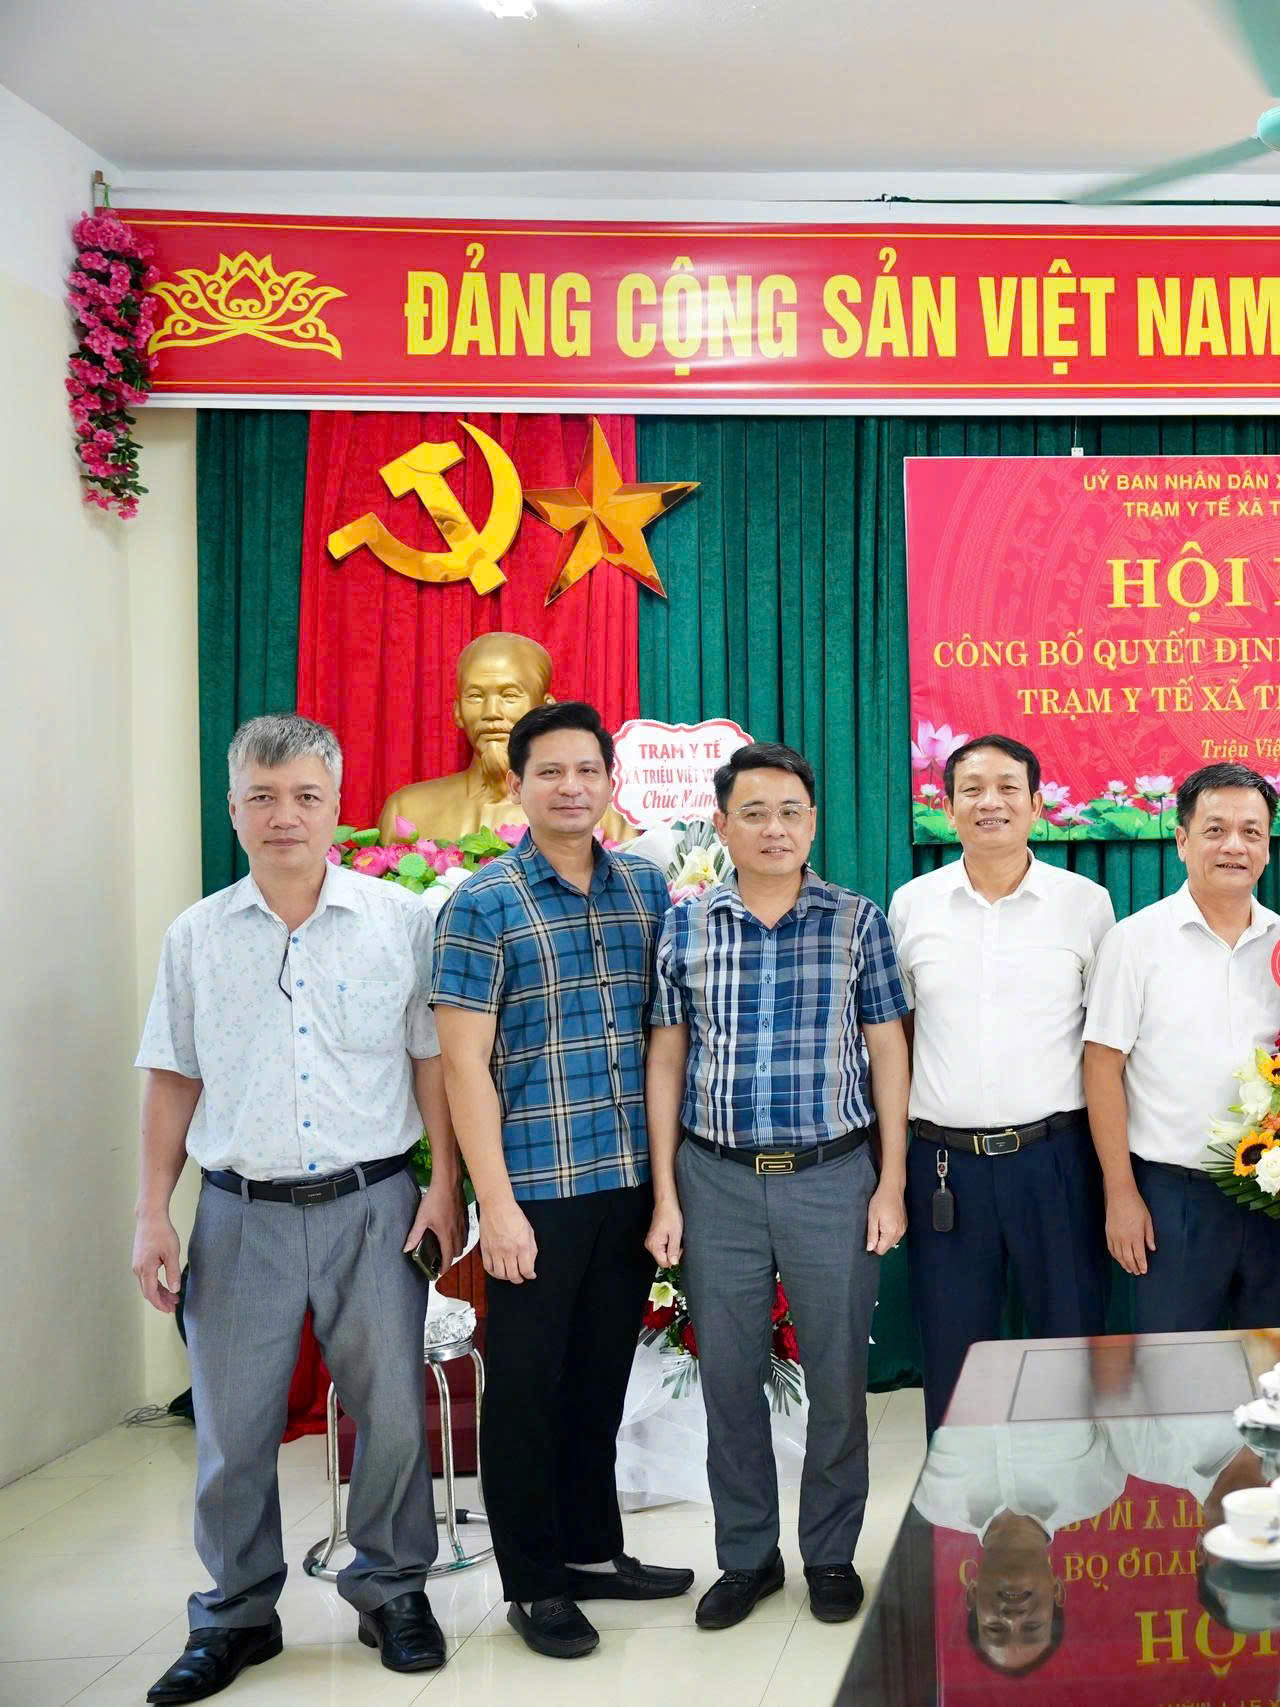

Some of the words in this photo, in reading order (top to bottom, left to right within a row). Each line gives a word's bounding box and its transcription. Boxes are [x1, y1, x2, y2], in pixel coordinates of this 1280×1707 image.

[404, 242, 591, 357] ĐẢNG
[617, 256, 798, 376] CỘNG
[821, 246, 957, 359] SẢN
[978, 258, 1115, 375] VIỆT
[1083, 468, 1109, 491] UỶ
[1116, 474, 1158, 490] BAN
[1165, 470, 1220, 490] NHÂN
[1228, 470, 1269, 490] DÂN
[1124, 501, 1180, 521] TRẠM
[1186, 501, 1199, 517] Y
[1205, 495, 1231, 517] TẾ
[1237, 497, 1264, 516] XÃ
[1106, 541, 1252, 624] HỘI
[933, 633, 1029, 668] CÔNG
[1039, 628, 1085, 667] BỐ
[1093, 628, 1206, 671] QUYẾT
[1017, 686, 1113, 721] TRẠM
[1120, 686, 1143, 713] Y
[1151, 675, 1195, 713] TẾ
[1201, 679, 1247, 712] XÃ
[689, 743, 699, 759] Y
[1201, 738, 1249, 764] Triệu
